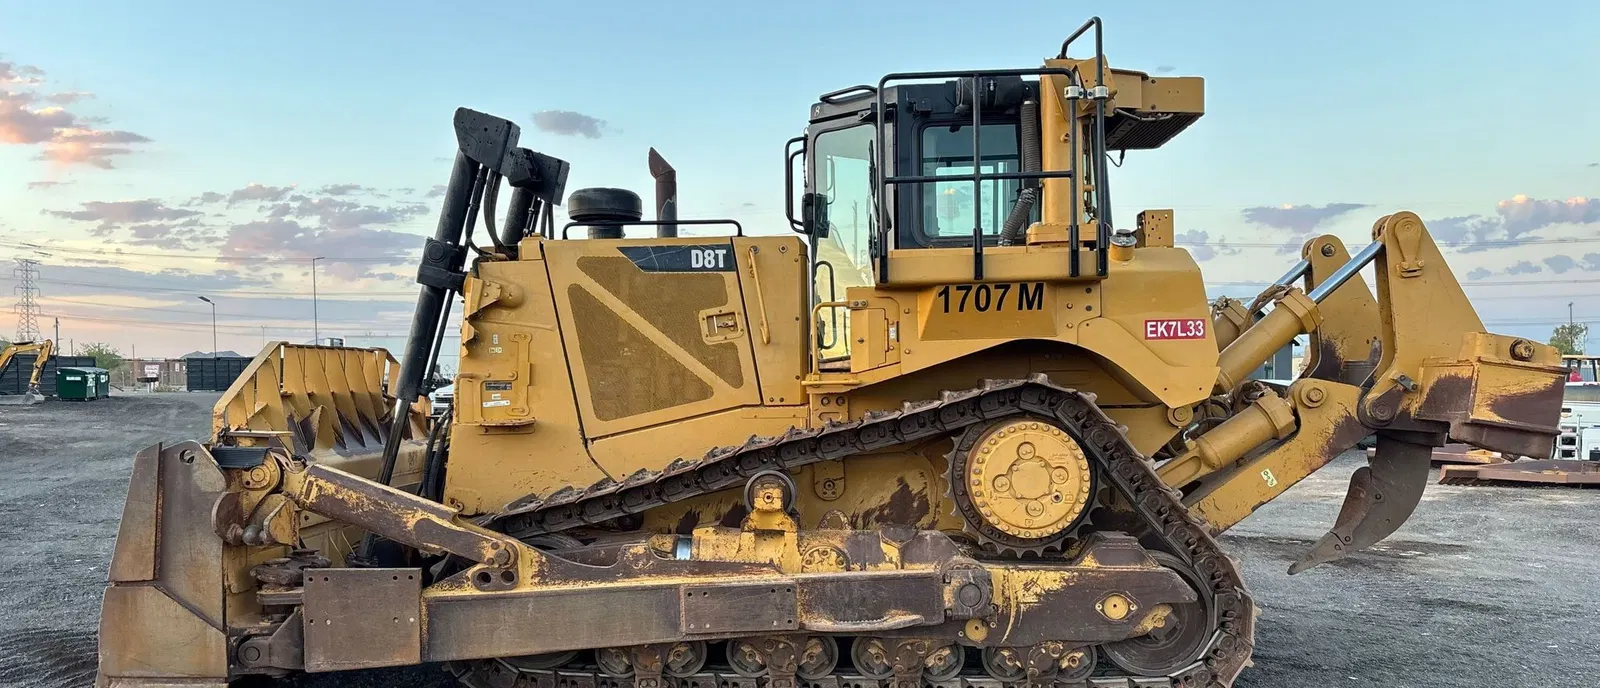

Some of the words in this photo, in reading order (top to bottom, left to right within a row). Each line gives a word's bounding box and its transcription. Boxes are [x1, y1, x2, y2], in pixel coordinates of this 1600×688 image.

[691, 249, 727, 269] D8T
[937, 284, 1012, 314] 1707
[1017, 282, 1045, 311] M
[1146, 320, 1204, 338] EK7L33
